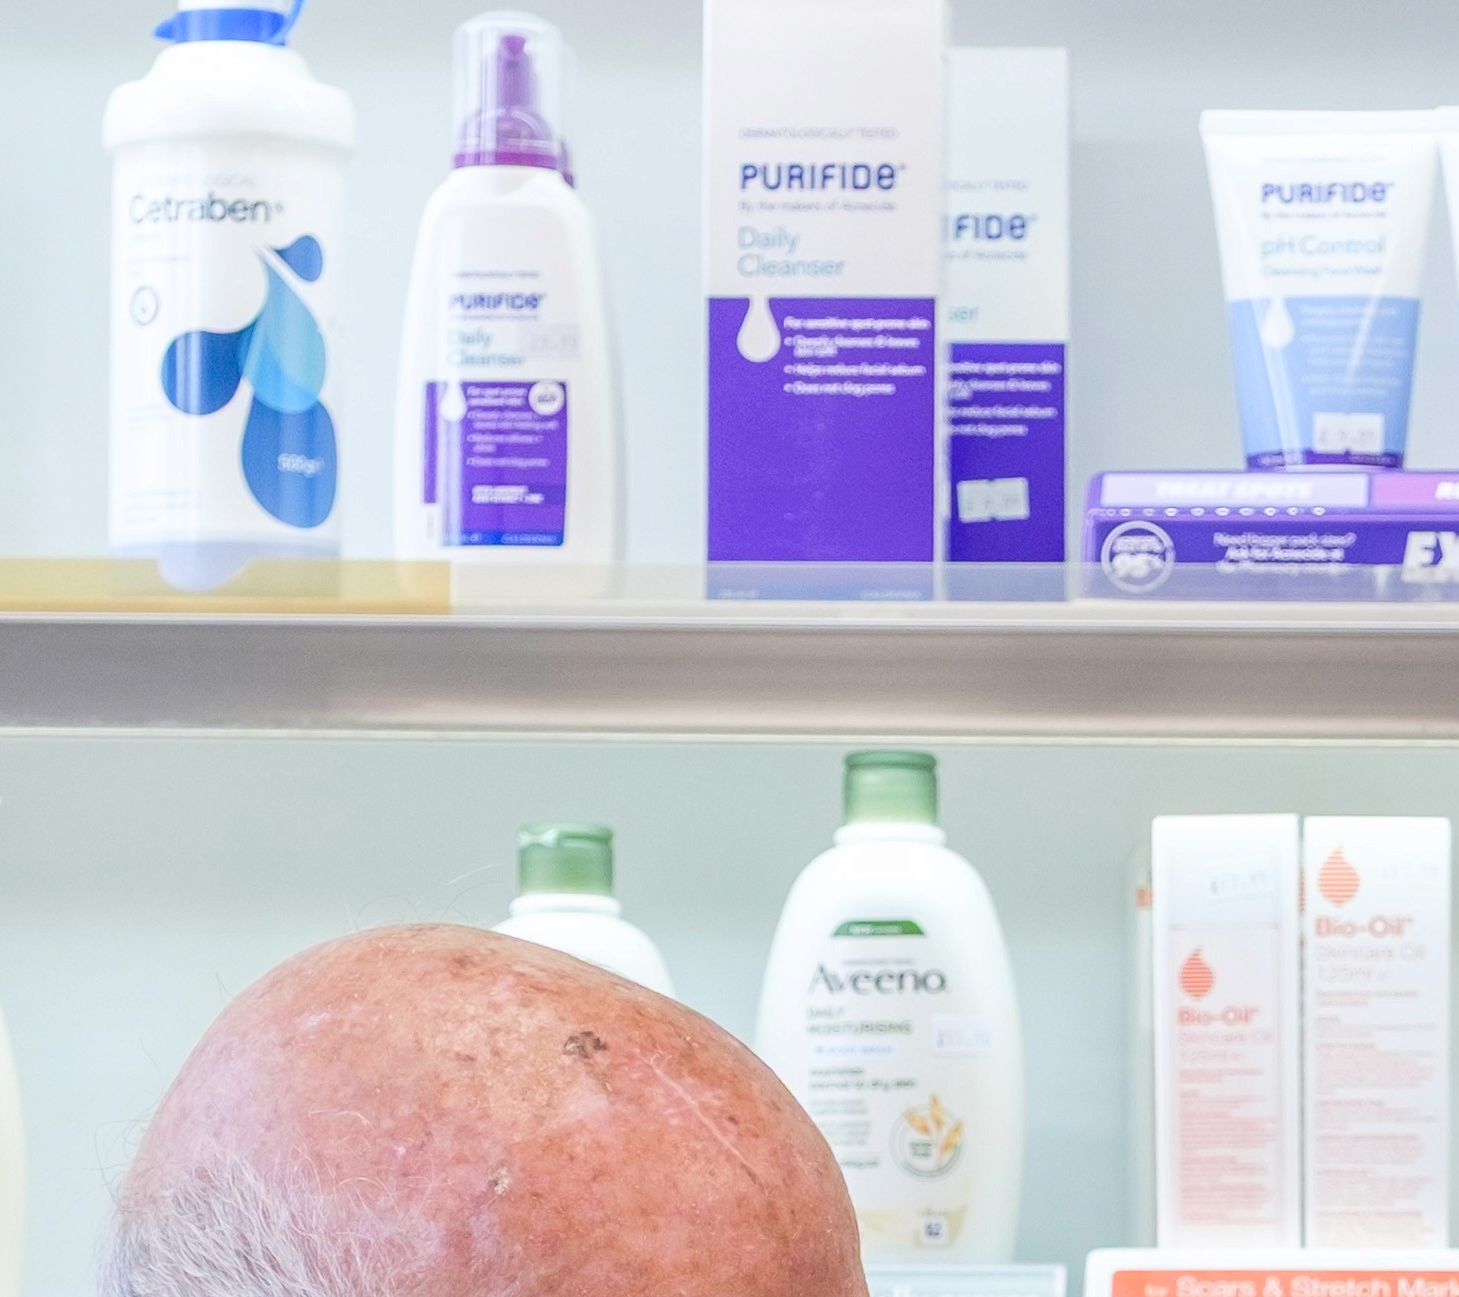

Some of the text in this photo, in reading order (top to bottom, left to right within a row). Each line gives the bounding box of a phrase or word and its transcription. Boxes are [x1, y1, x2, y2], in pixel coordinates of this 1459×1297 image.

[130, 192, 272, 224] Cetraben
[944, 214, 1027, 240] IFIDE
[808, 962, 947, 995] Aveeno
